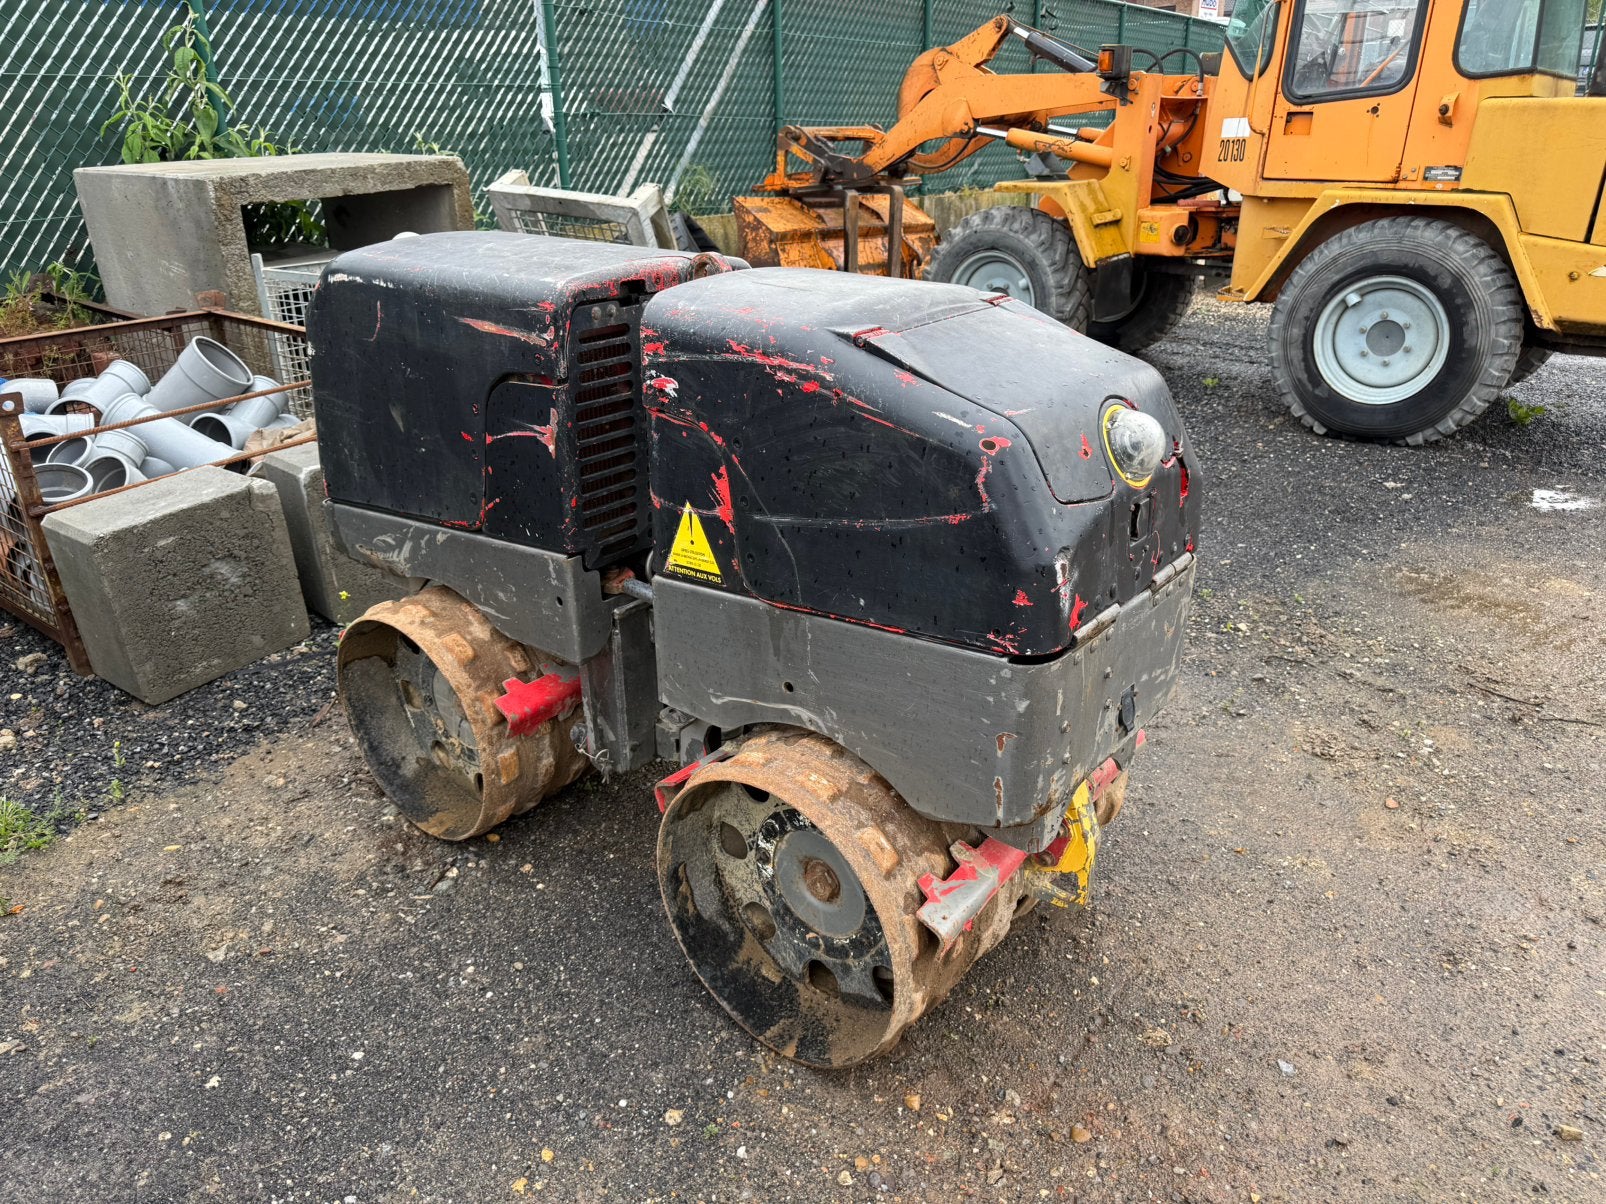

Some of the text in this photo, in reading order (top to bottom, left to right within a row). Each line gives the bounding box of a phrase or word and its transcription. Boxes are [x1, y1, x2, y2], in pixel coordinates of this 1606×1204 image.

[1218, 139, 1246, 162] 20130
[668, 565, 722, 584] ATTENTION AUX VOLS
